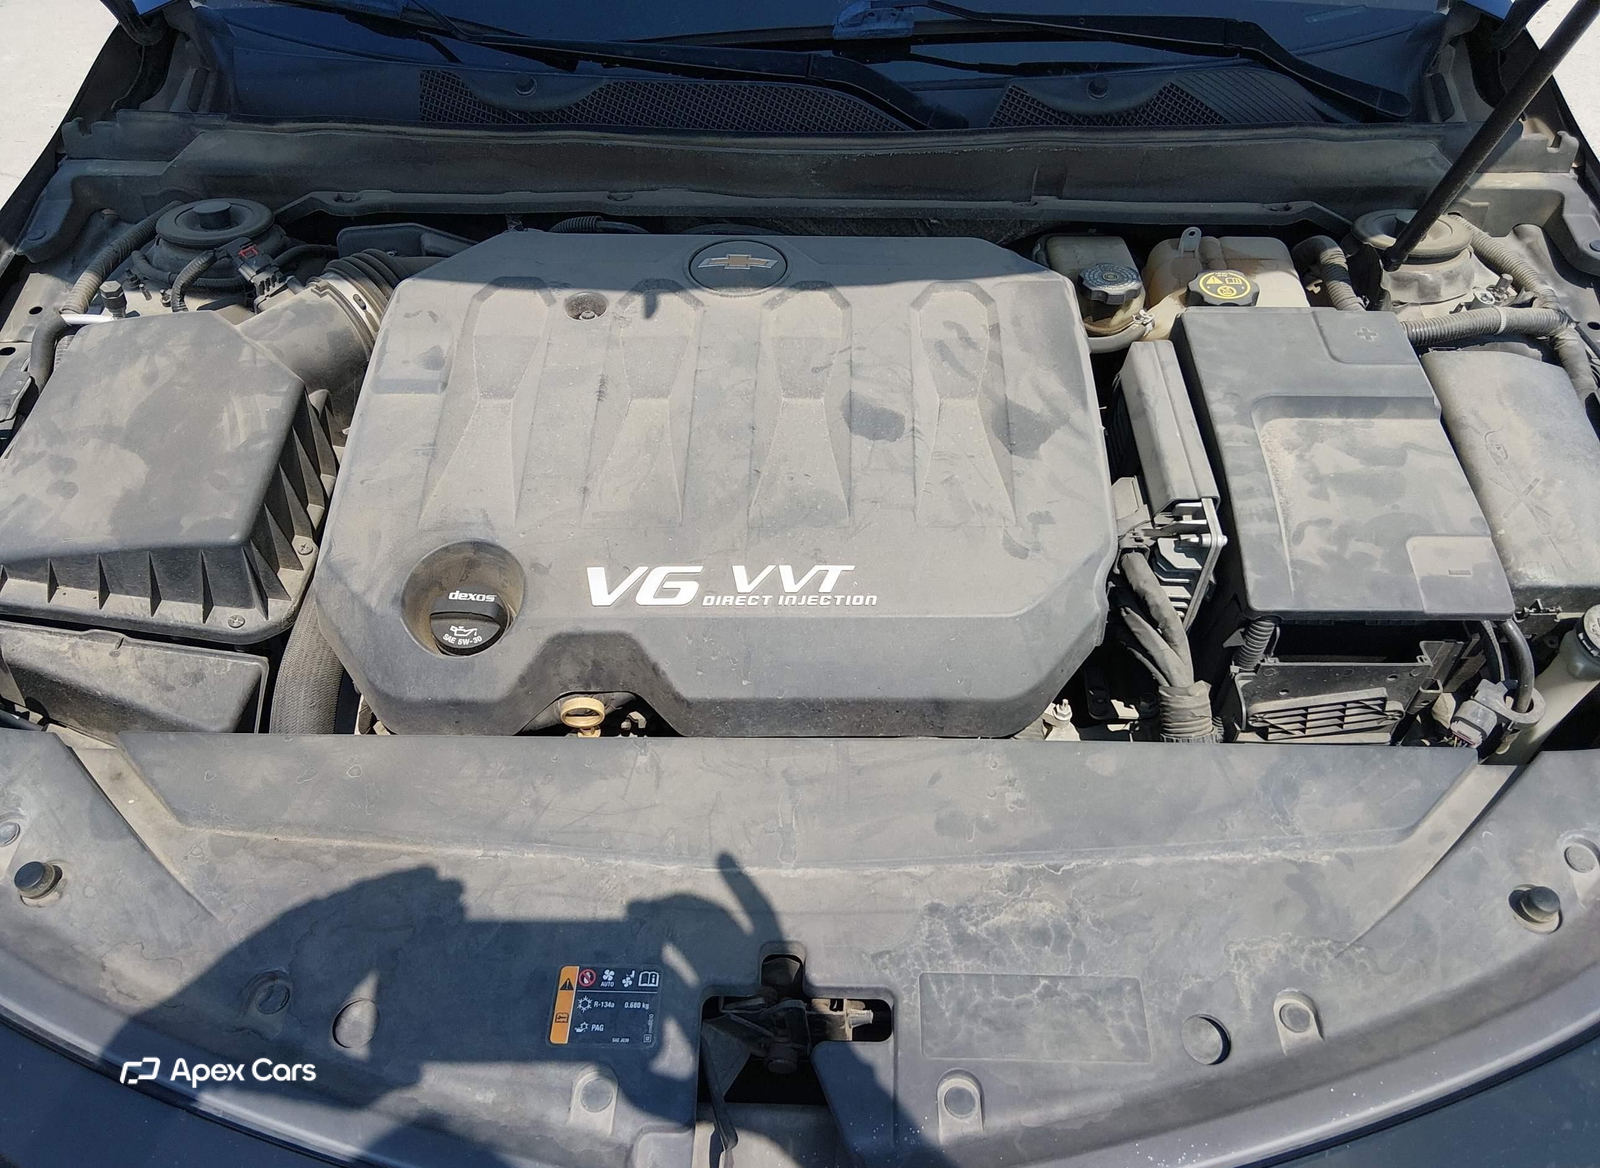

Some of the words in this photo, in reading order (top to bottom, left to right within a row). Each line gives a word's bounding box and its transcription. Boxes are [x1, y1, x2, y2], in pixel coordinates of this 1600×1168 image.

[586, 566, 704, 607] V6
[732, 565, 856, 593] VVT
[448, 590, 497, 602] dexos
[702, 595, 774, 606] DIRECT
[778, 595, 877, 606] INJECTION
[442, 633, 457, 645] SAE
[457, 635, 483, 646] 5W-30
[593, 1001, 615, 1009] R-134a
[642, 1002, 650, 1010] kg
[591, 1023, 604, 1032] PAG
